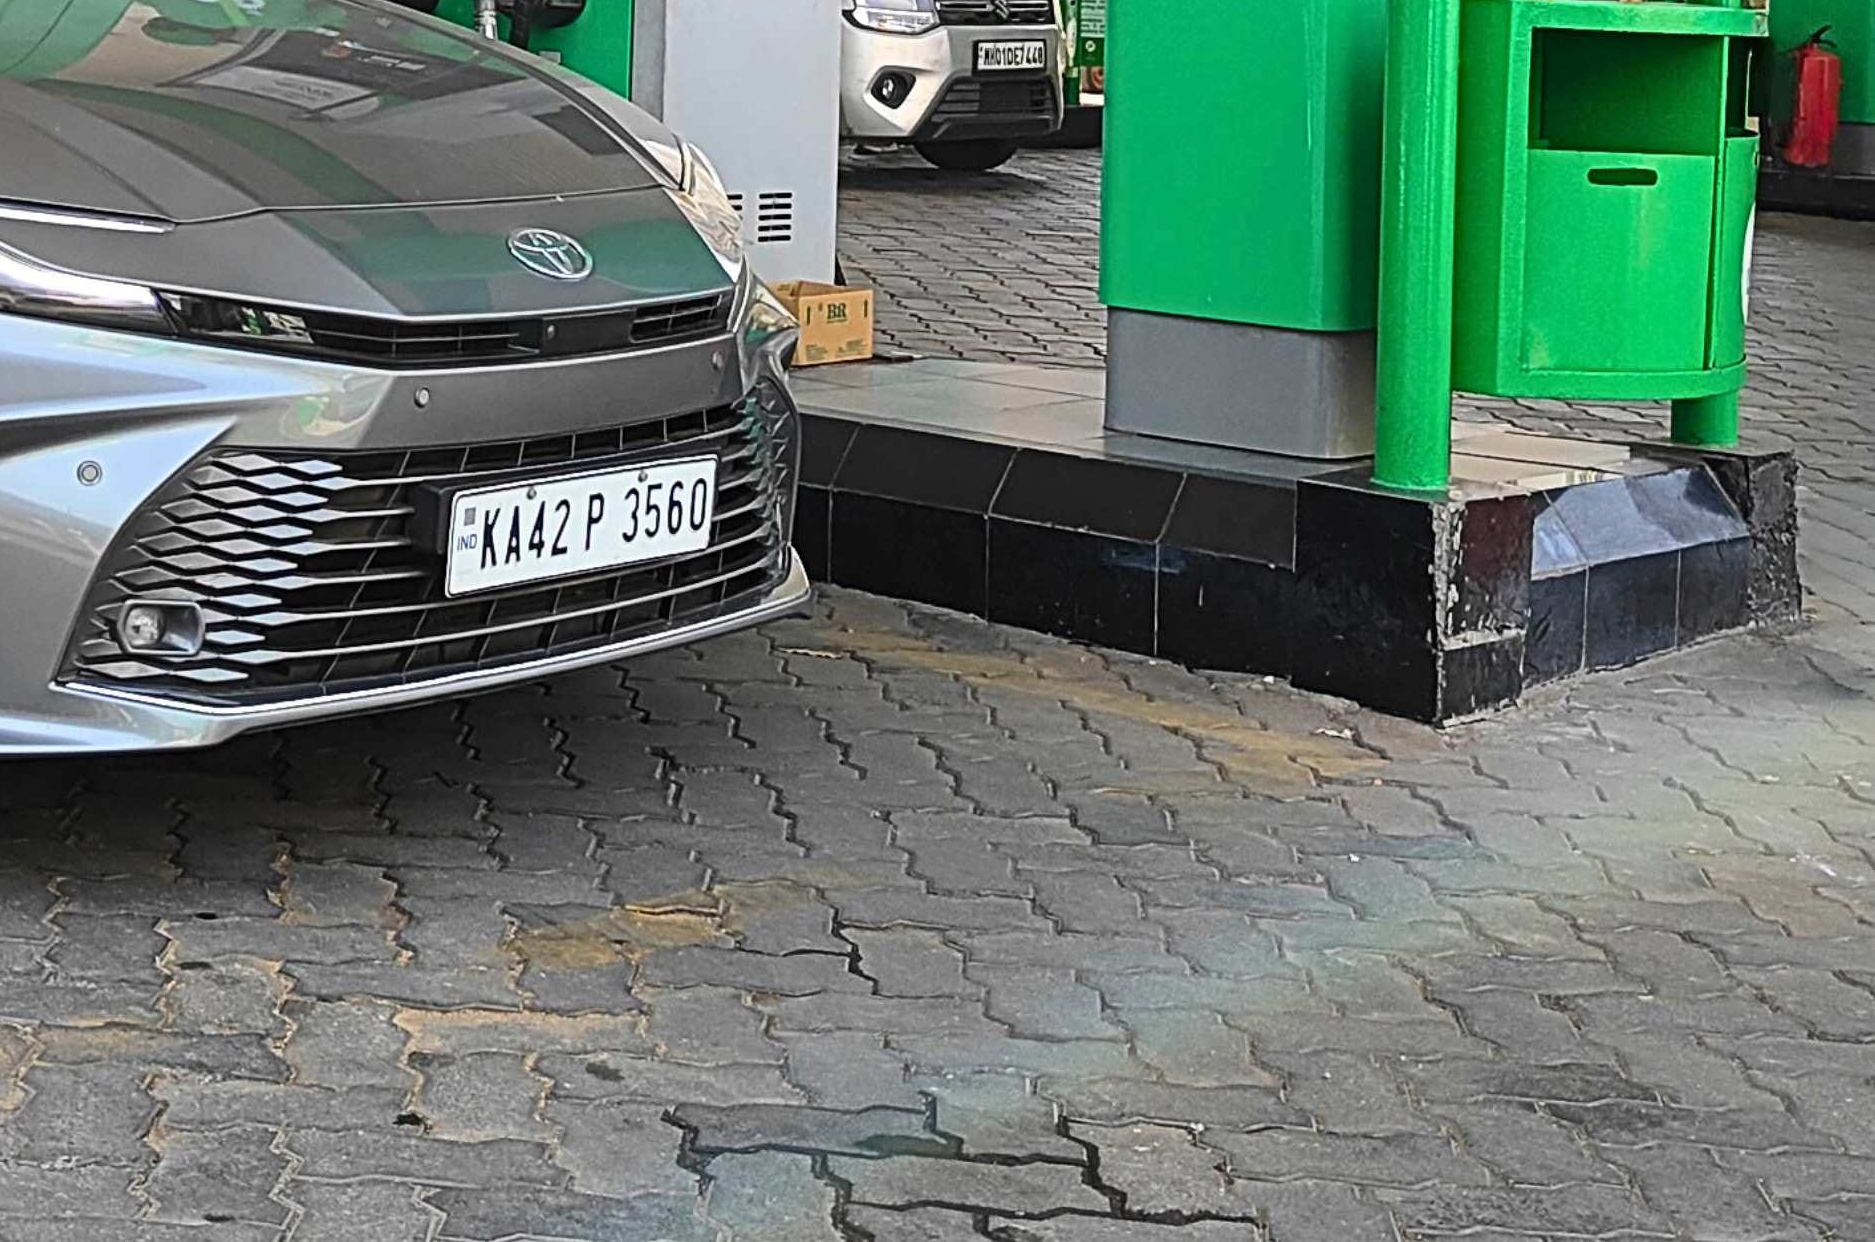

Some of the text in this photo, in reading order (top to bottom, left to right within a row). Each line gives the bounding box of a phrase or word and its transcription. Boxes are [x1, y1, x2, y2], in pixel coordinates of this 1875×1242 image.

[457, 478, 708, 569] IND KA42 P 3560
